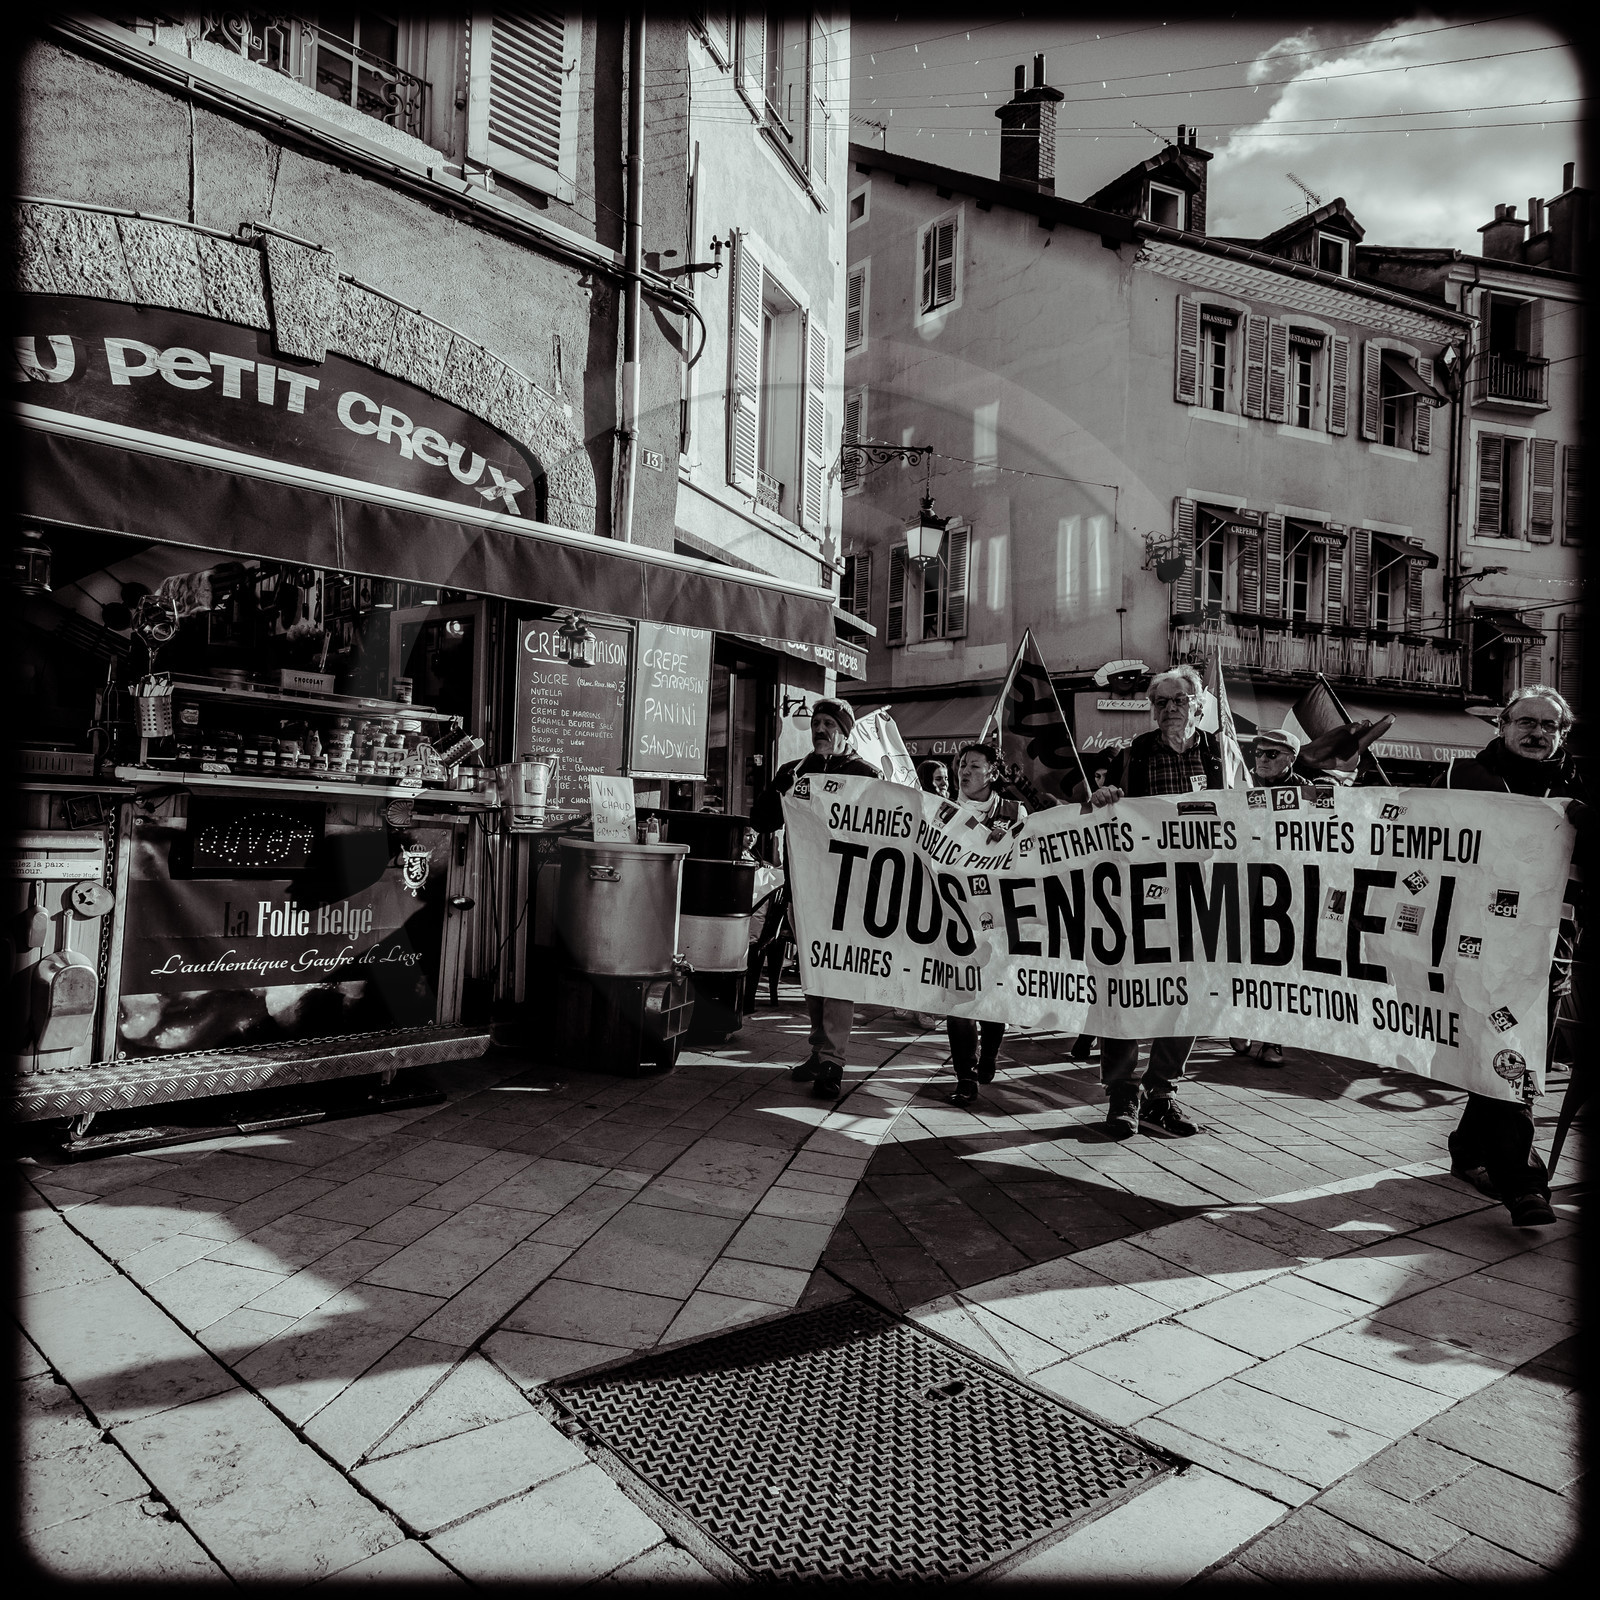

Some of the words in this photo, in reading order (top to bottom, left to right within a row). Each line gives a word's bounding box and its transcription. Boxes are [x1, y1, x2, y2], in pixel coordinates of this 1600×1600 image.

[1202, 312, 1233, 327] BRASSERIE
[1290, 333, 1322, 347] ESTAURANT
[646, 452, 659, 467] 13
[1313, 535, 1342, 546] COCKTAIL
[1503, 635, 1522, 643] SALON
[1523, 636, 1531, 644] DE
[643, 648, 689, 674] CREPE
[294, 676, 323, 685] CHOCOLAT
[531, 671, 569, 686] SUCRE
[530, 687, 563, 697] NUTELLA
[530, 696, 560, 706] CITRON
[561, 708, 570, 717] DE
[572, 710, 601, 719] MARRONS
[531, 716, 566, 726] CARAMEL
[568, 719, 595, 729] BEURRE
[531, 725, 559, 735] BEURRE
[563, 728, 571, 736] DE
[530, 745, 564, 754] SPECULOS
[562, 756, 583, 764] ETOILE
[574, 764, 605, 774] BANANE
[596, 781, 614, 796] VIN
[1248, 793, 1267, 804] cgt
[1276, 789, 1295, 806] FO
[1316, 797, 1335, 808] cgt
[601, 800, 631, 811] CHAUD
[828, 801, 913, 839] SALARIÉS
[1038, 816, 1135, 866] RETRAITÉS
[1157, 820, 1237, 851] JEUNES
[1275, 814, 1355, 854] PRIVÉS
[1370, 822, 1482, 865] D'EMPLOI
[972, 877, 987, 891] FO
[827, 838, 977, 957] TOUS
[998, 861, 1399, 986] ENSEMBLE
[1495, 904, 1519, 917] cgt
[223, 902, 249, 938] La
[256, 900, 310, 938] Folie
[317, 900, 374, 942] Belge
[1398, 915, 1415, 923] ASSEZ
[1459, 942, 1481, 954] cgt
[150, 949, 289, 976] L'authentique
[290, 946, 355, 974] Gaufre
[358, 948, 376, 965] de
[810, 940, 893, 978] SALAIRES
[921, 957, 983, 992] EMPLOI
[1016, 967, 1097, 1005] SERVICES
[1108, 975, 1188, 1009] PUBLICS
[1232, 977, 1360, 1025] PROTECTION
[1372, 997, 1460, 1048] SOCIALE
